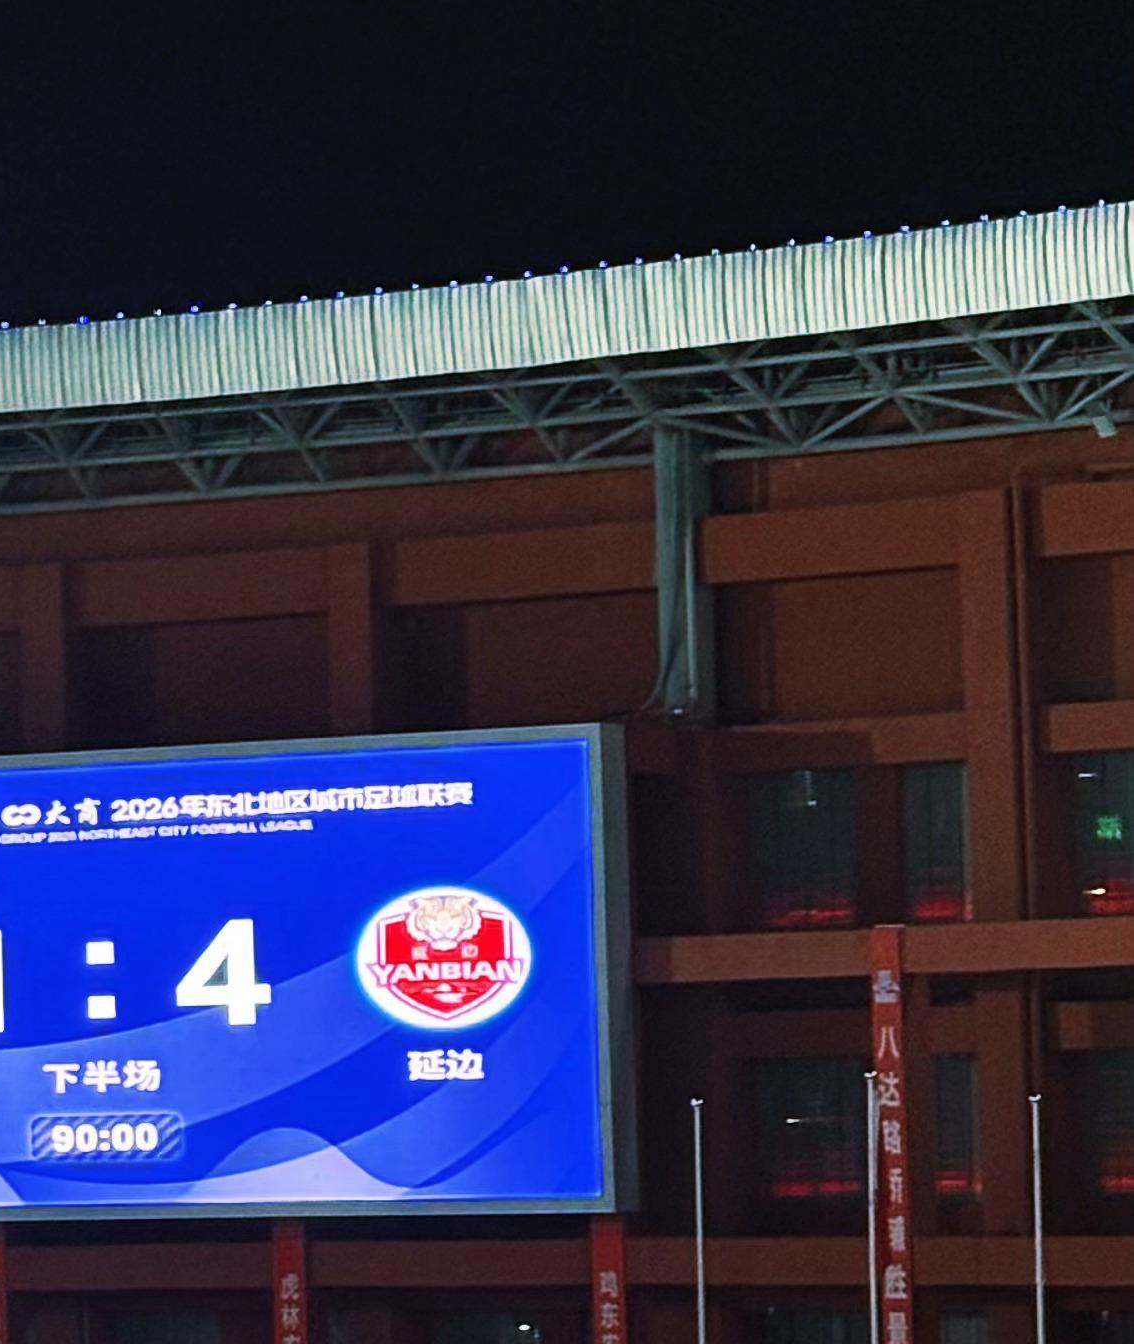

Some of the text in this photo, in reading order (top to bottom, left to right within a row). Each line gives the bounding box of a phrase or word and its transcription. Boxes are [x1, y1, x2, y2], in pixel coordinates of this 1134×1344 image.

[110, 782, 474, 822] 2026年东北地区城市足球联赛
[176, 918, 272, 1026] 4
[367, 958, 524, 989] YANBIAN
[42, 1060, 161, 1094] 下半场
[407, 1049, 484, 1081] 延边
[51, 1123, 159, 1153] 90:00
